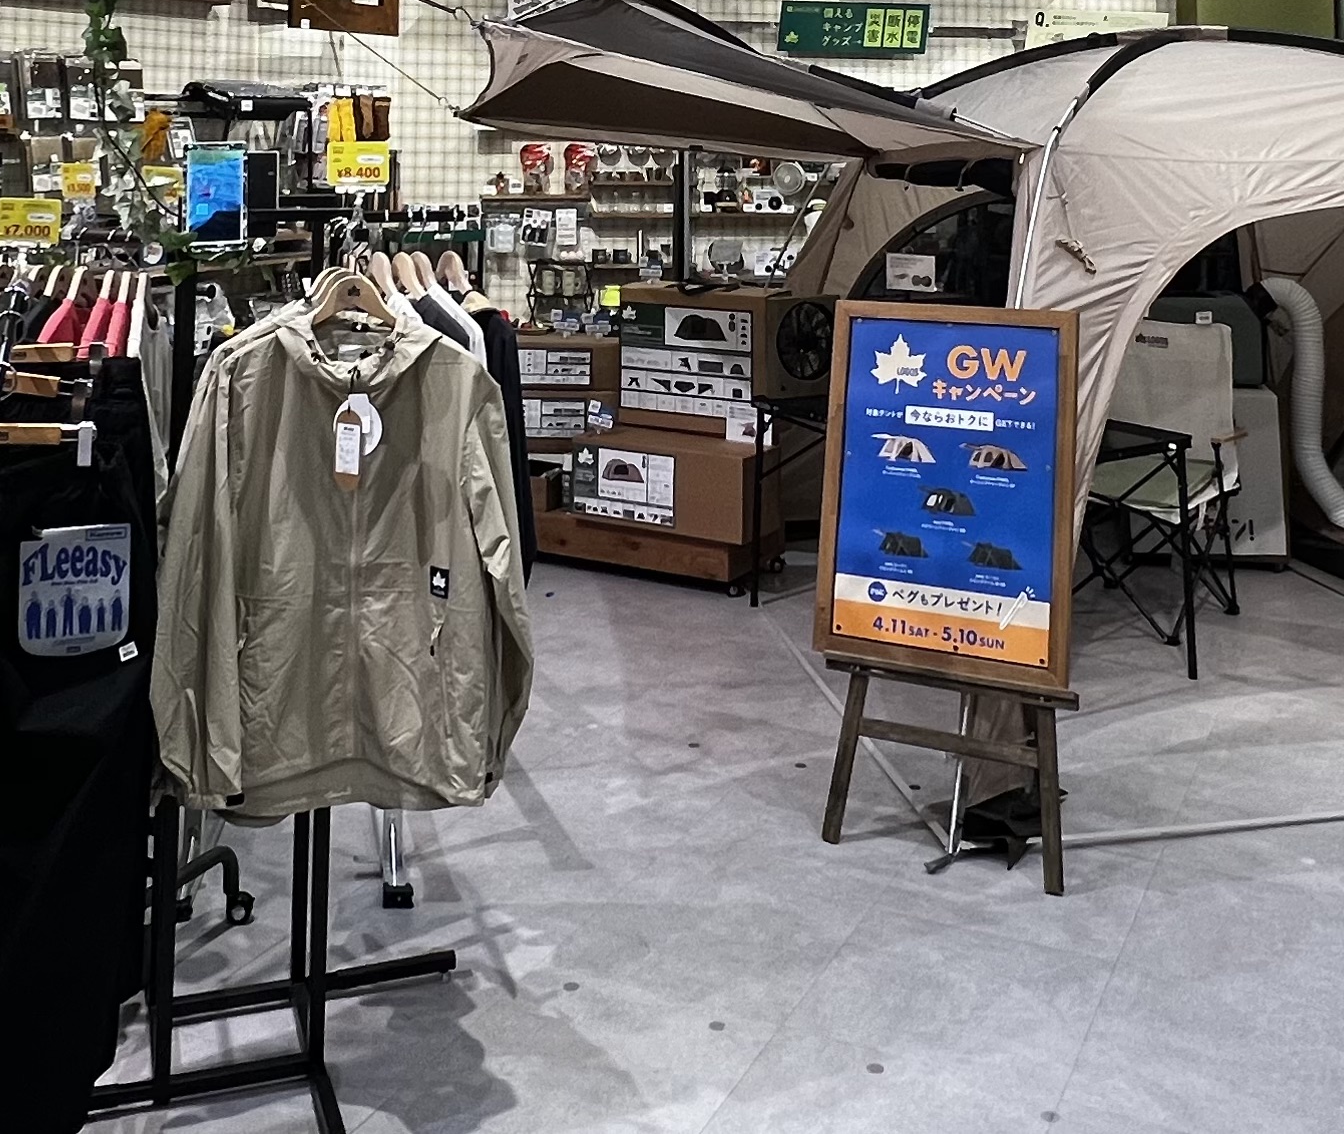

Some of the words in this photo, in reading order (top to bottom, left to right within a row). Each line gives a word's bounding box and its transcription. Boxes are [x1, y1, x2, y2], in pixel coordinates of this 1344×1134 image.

[822, 22, 863, 33] キャンプ
[885, 14, 901, 44] 断水
[337, 166, 381, 179] ¥8,400
[6, 224, 51, 238] ¥7,000
[947, 344, 1027, 382] GW
[932, 379, 1037, 405] キャンペーン
[909, 409, 989, 428] 今ならおトクに
[22, 543, 128, 586] FLeeasy
[892, 588, 1003, 616] ペグもプレゼント!
[873, 616, 906, 635] 4.11
[908, 625, 929, 638] SAT
[941, 626, 979, 646] 5.10
[979, 634, 1005, 650] SUN
